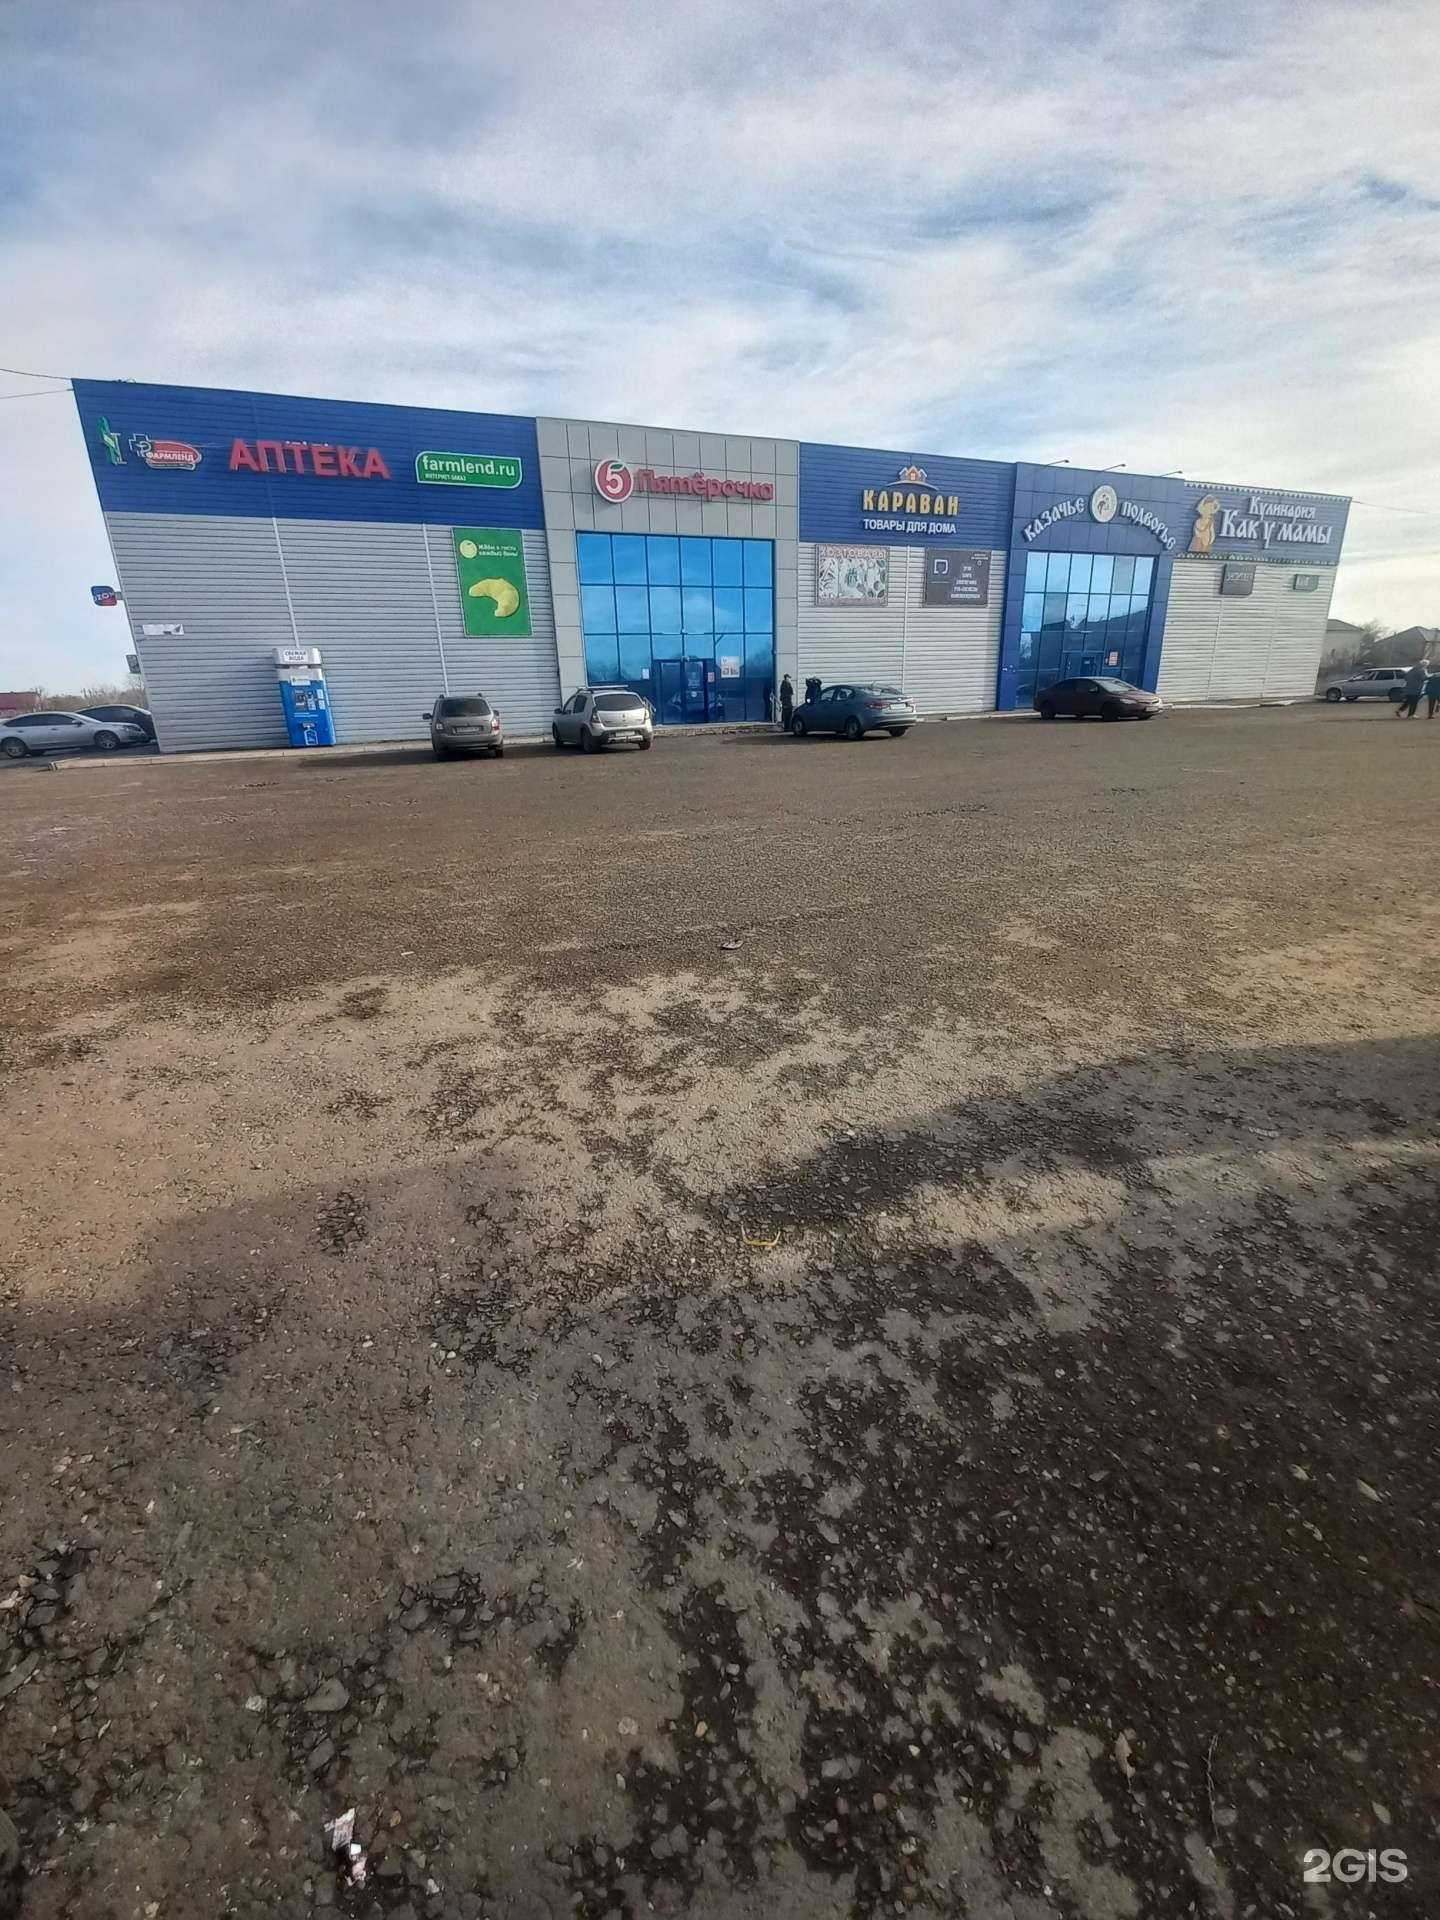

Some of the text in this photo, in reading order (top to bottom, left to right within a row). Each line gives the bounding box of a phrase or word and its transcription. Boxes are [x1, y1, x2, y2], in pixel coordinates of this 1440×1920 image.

[146, 450, 195, 461] ФАРМЛЕНД
[229, 438, 391, 479] АПТЕКА
[422, 455, 515, 476] farmlend.ru
[637, 469, 774, 501] Пятёрочка
[862, 489, 959, 516] КАРАВАН
[1249, 496, 1317, 523] Кулинария
[863, 519, 957, 534] ТОВАРЫ ДЛЯ ДОМА
[1023, 497, 1176, 550] КАЗАЧЬЕ ПОДВОРЬЕ
[1220, 509, 1333, 549] Как у мамы
